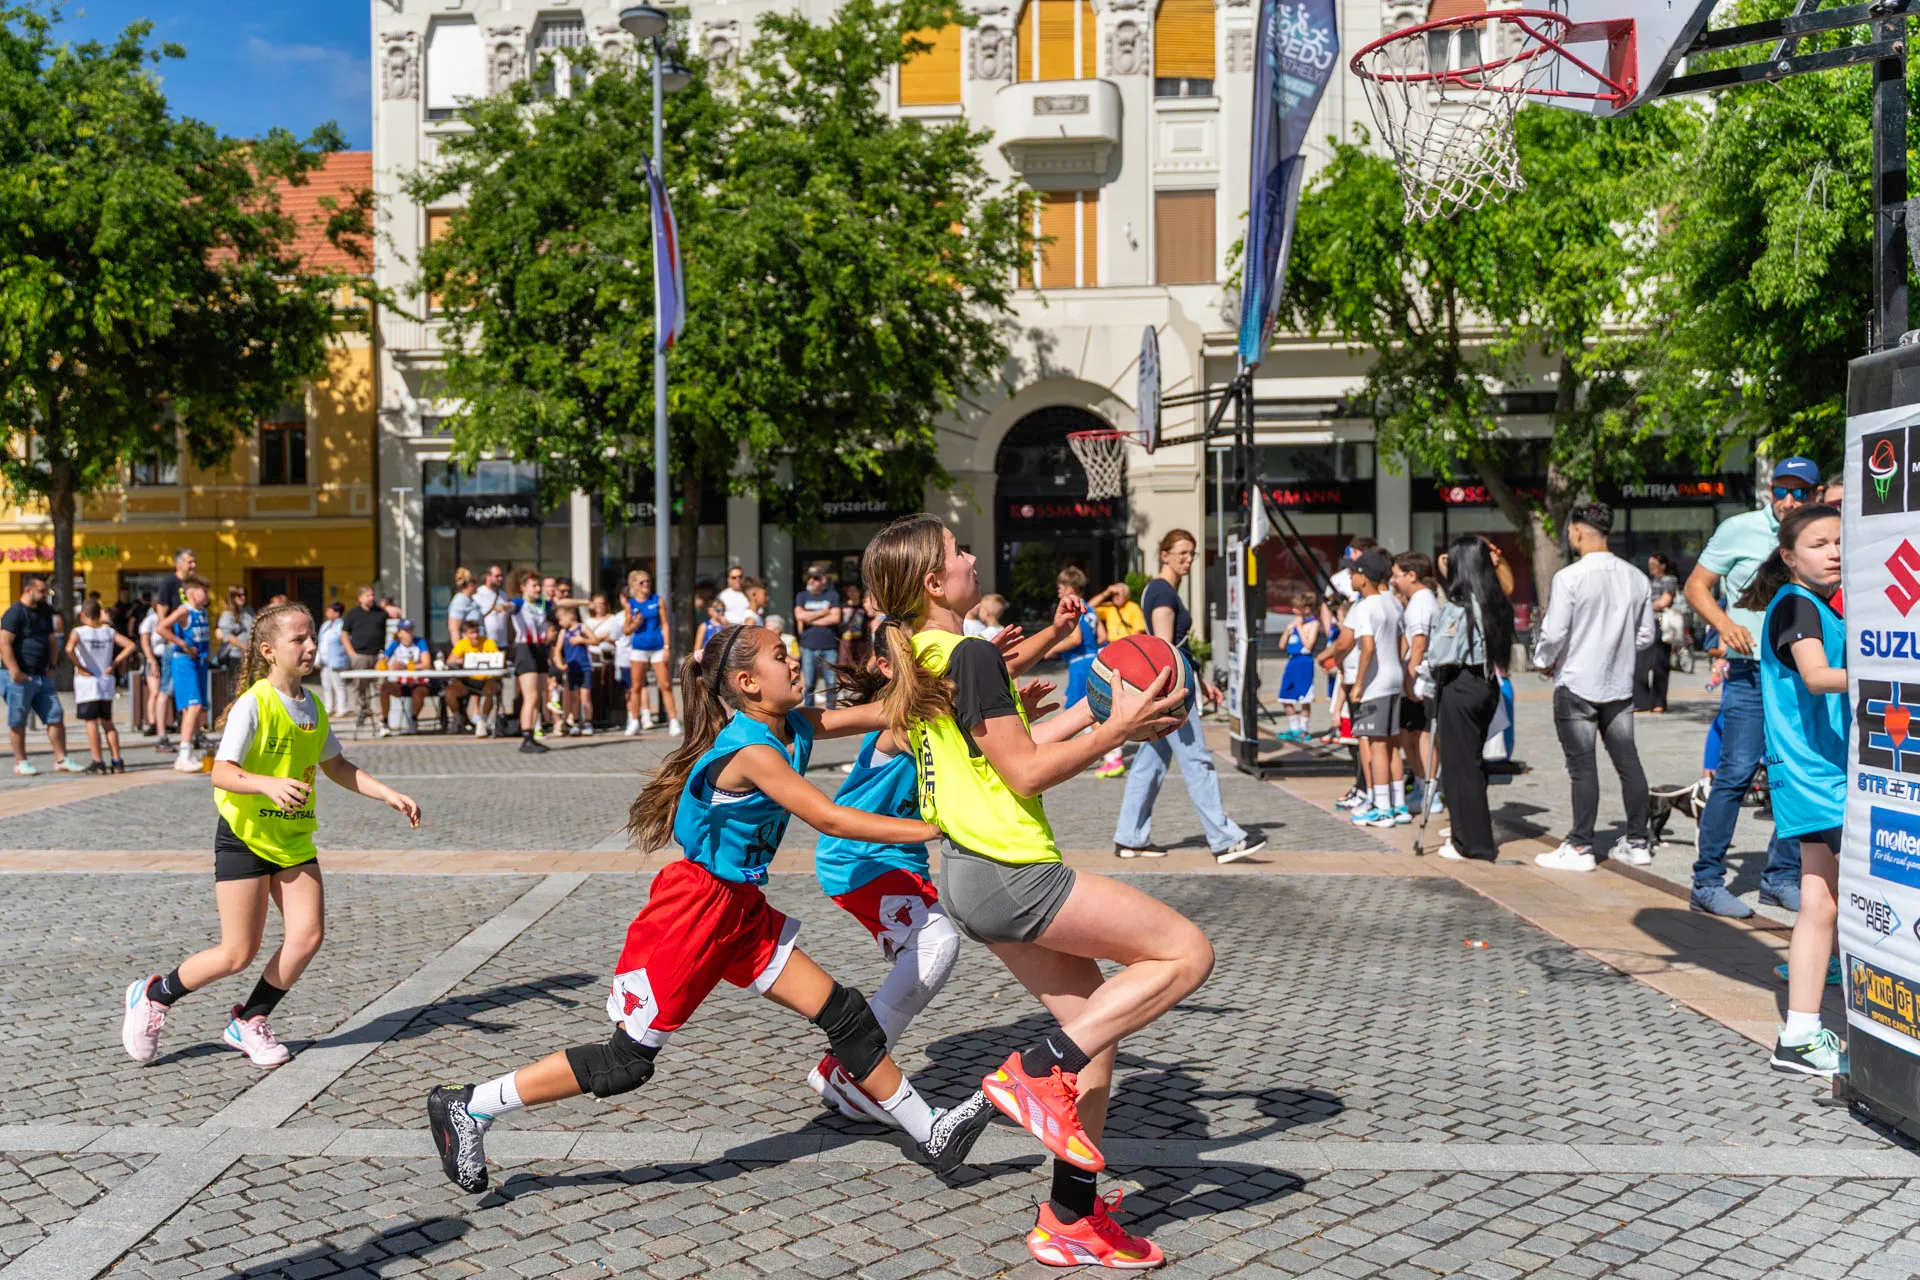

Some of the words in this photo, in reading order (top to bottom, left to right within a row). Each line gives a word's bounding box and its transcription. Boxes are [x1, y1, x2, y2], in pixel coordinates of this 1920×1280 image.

[465, 504, 530, 521] Apotheke
[1858, 772, 1920, 802] STREET
[1851, 893, 1891, 920] POWER
[1866, 913, 1890, 935] ADE
[1866, 969, 1894, 1006] KING
[1897, 989, 1911, 1013] OF
